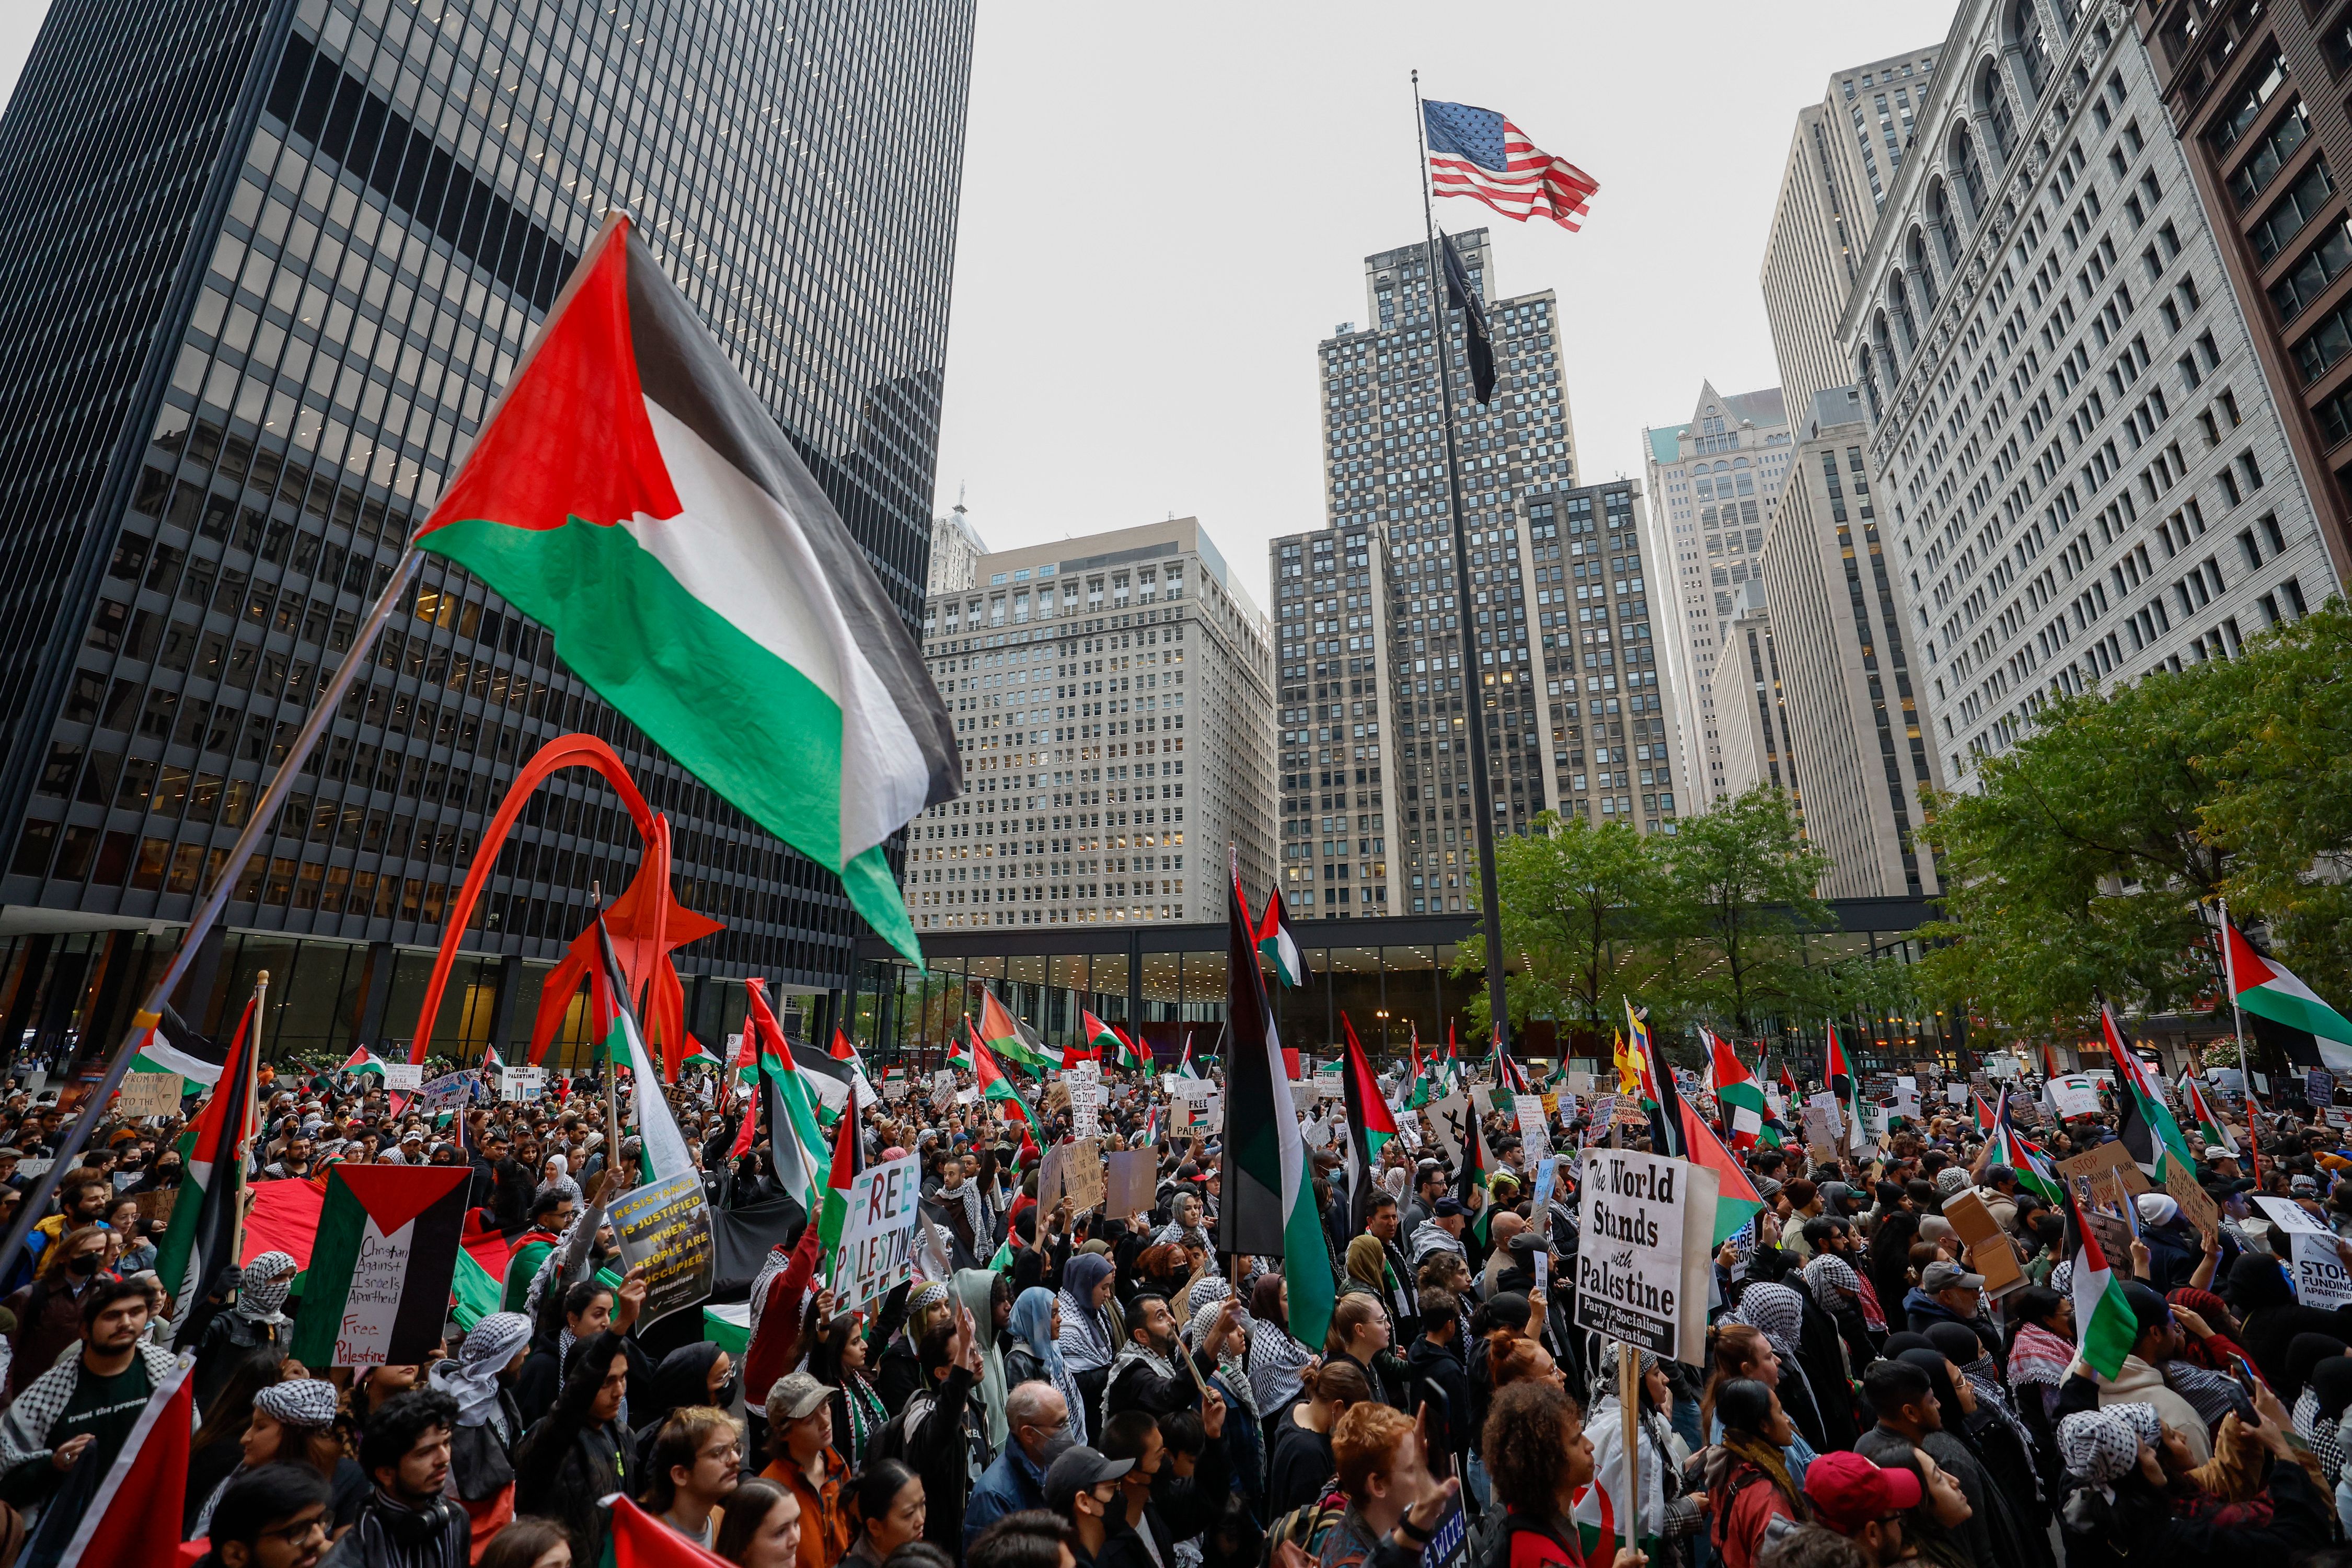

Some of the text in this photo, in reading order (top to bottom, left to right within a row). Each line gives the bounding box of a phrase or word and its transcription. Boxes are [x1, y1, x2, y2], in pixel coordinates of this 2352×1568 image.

[1069, 1070, 1096, 1082] THIS IS NOT
[662, 1087, 686, 1102] REE
[1070, 1082, 1096, 1091] ABOUT RELIGION
[1180, 1082, 1195, 1093] STOP
[1071, 1092, 1081, 1103] THIS
[1082, 1092, 1088, 1103] IS
[1189, 1099, 1207, 1109] FREE
[1540, 1093, 1555, 1101] STOP
[1811, 1095, 1835, 1108] ISRAEL
[2057, 1092, 2089, 1104] Palestine
[1073, 1104, 1098, 1116] ABOUT SECURITY
[1073, 1114, 1095, 1125] THIS IS
[1826, 1105, 1838, 1114] MBS
[1075, 1125, 1096, 1137] ABOUT LAND
[1399, 1119, 1416, 1127] CEASE
[1865, 1135, 1881, 1147] OW
[1062, 1142, 1088, 1162] FROM THE
[1069, 1164, 1077, 1175] TO
[1088, 1155, 1097, 1165] SEA
[2072, 1155, 2097, 1174] STOP
[1065, 1168, 1100, 1193] PALESTINE WILL
[1589, 1159, 1675, 1204] The World
[2072, 1161, 2135, 1191] BBING OUR
[2180, 1168, 2198, 1197] SAVE
[614, 1178, 696, 1220] RESISTANCE
[1087, 1185, 1099, 1203] FREE
[2167, 1177, 2183, 1201] FROM
[2169, 1169, 2205, 1215] PALESTINE
[850, 1166, 914, 1233] FREE
[621, 1195, 700, 1237] IS JUSTIFIED
[1594, 1200, 1658, 1248] Stands
[2106, 1219, 2122, 1231] THE
[649, 1221, 688, 1243] WHEN
[1729, 1232, 1753, 1249] FIRE
[2089, 1226, 2113, 1240] RIVER
[361, 1236, 408, 1259] Christian
[635, 1231, 708, 1269] PEOPLE ARE
[356, 1256, 402, 1276] Against
[834, 1225, 916, 1296] PALESTINE
[1611, 1249, 1633, 1269] with
[644, 1254, 704, 1286] OCCUPIED
[2300, 1260, 2349, 1281] STOP
[350, 1271, 400, 1291] Israel's
[1579, 1255, 1675, 1317] Palestine
[2302, 1276, 2352, 1292] FUNDING
[348, 1289, 398, 1305] Apartheid
[2304, 1286, 2351, 1300] APARTHEID
[1174, 1298, 1189, 1319] TO
[1584, 1296, 1608, 1319] Party
[1616, 1310, 1665, 1336] Socialism
[343, 1313, 379, 1335] Free
[1592, 1318, 1653, 1348] and Liberation
[336, 1339, 386, 1365] Palestine
[68, 1397, 148, 1424] trust the process
[1432, 1510, 1464, 1564] WITH
